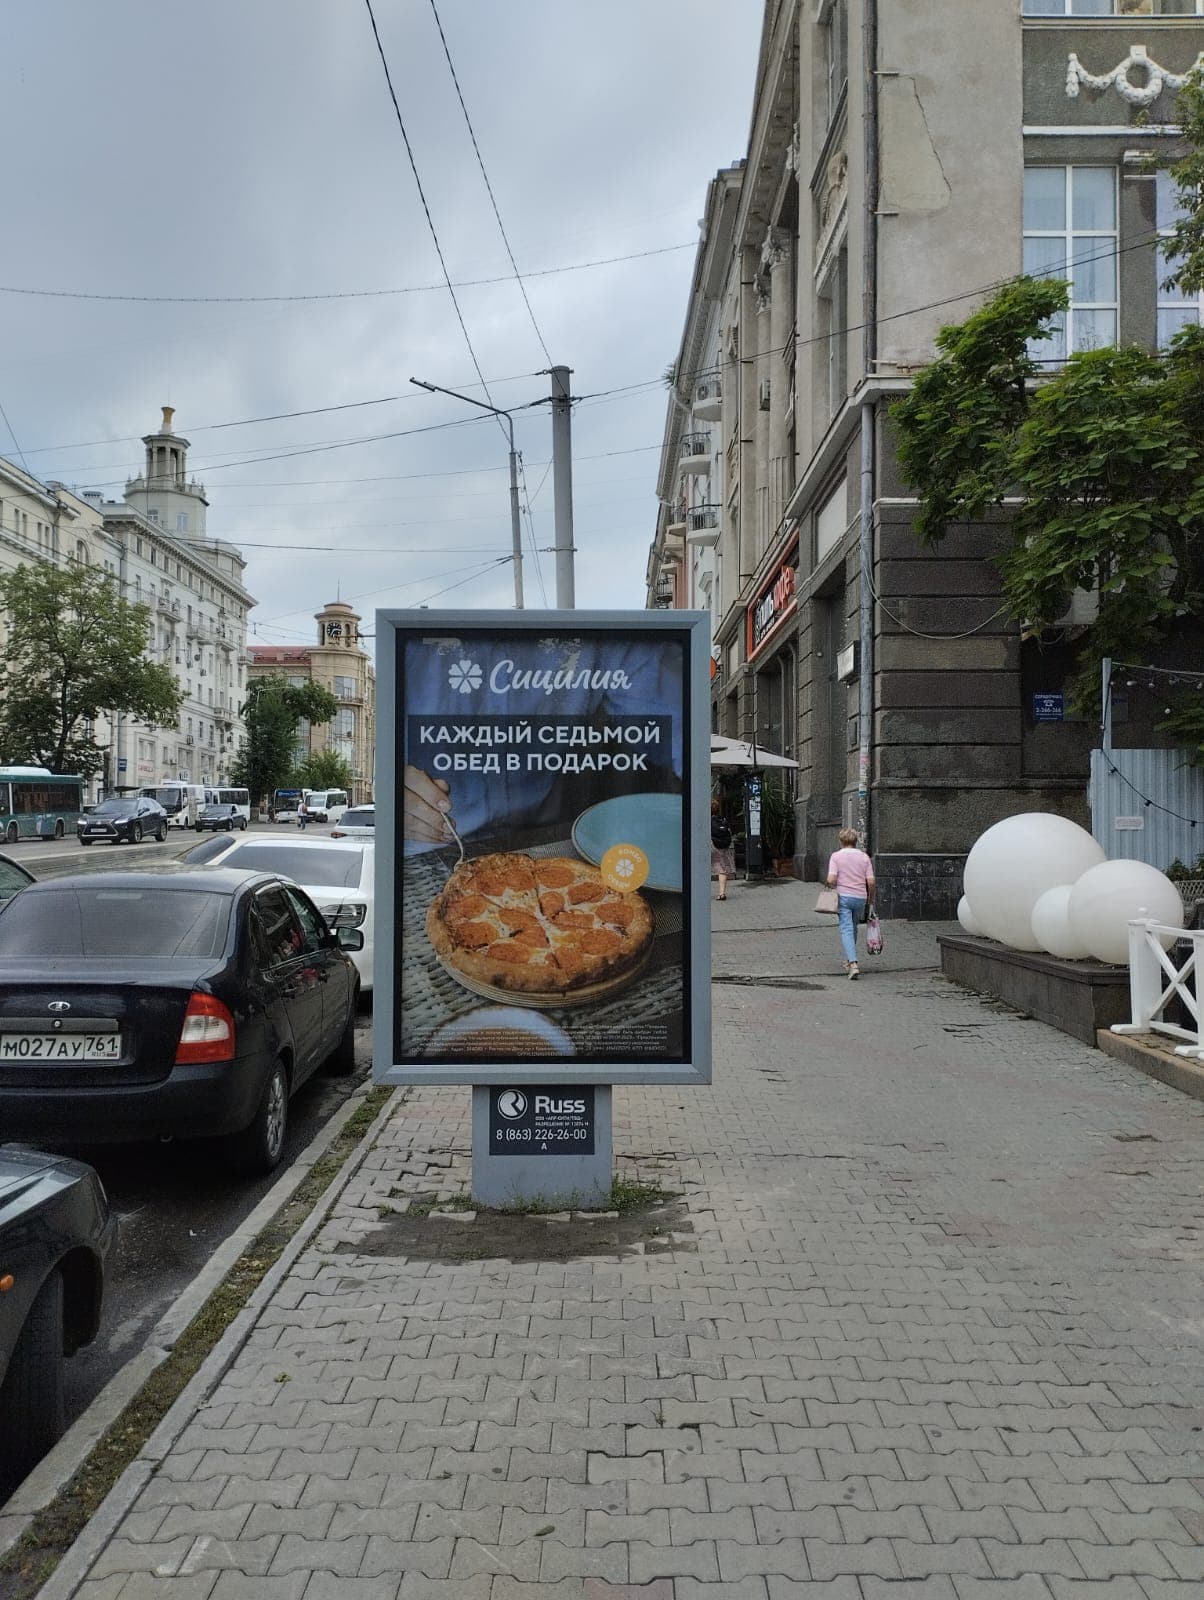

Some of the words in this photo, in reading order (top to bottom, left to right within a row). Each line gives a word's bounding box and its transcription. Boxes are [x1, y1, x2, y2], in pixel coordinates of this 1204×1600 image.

[489, 659, 632, 695] Сицилия
[420, 721, 532, 747] КАЖДЫЙ
[538, 721, 660, 747] СЕДЬМОЙ
[433, 753, 500, 773] ОБЕД
[506, 753, 521, 771] В
[527, 753, 648, 773] ПОДАРОК
[86, 1037, 116, 1052] 761
[535, 1095, 586, 1114] Russ
[496, 1129, 503, 1140] 8
[506, 1128, 532, 1141] (863)
[535, 1129, 587, 1140] 226-26-00
